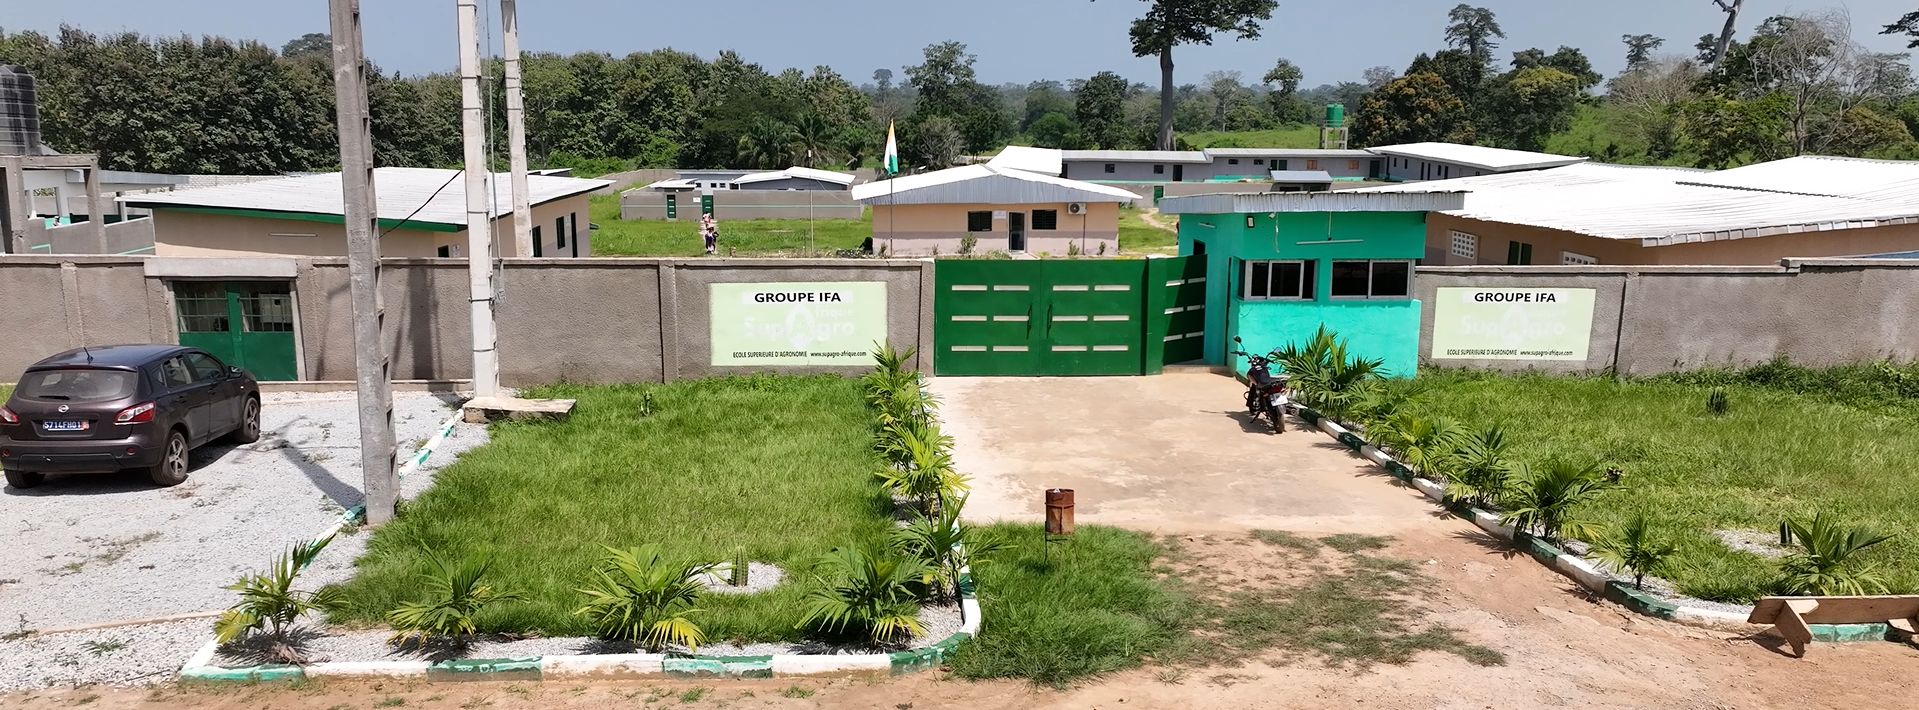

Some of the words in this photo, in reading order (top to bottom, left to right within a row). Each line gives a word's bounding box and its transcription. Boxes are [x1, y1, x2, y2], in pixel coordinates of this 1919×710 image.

[754, 292, 815, 303] GROUPE
[819, 292, 842, 303] IFA
[1474, 292, 1532, 303] GROUPE
[1535, 292, 1556, 303] IFA
[810, 350, 867, 359] www.supagro-afrique.com
